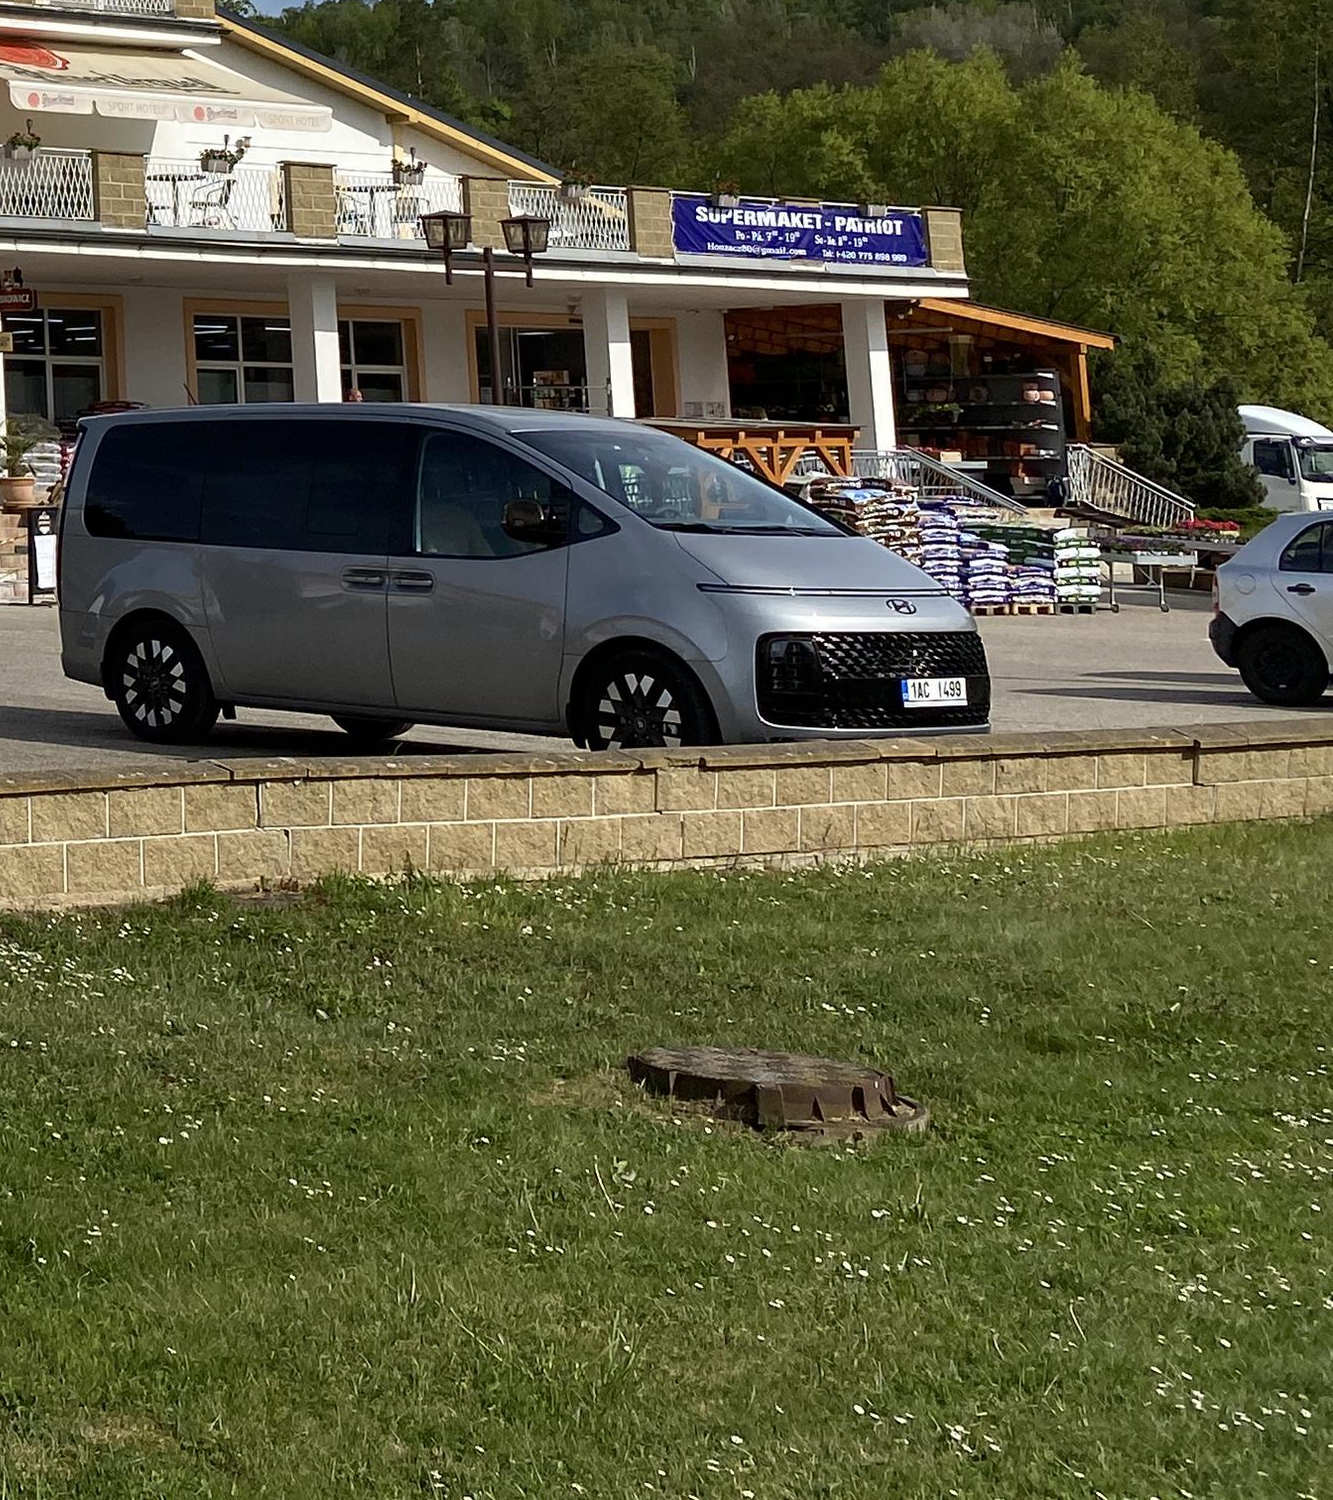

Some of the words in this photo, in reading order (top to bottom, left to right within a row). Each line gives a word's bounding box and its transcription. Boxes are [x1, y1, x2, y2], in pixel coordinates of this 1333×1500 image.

[695, 205, 823, 230] SUPERMAKET
[834, 215, 903, 236] PATRIOT
[911, 681, 930, 699] 1AC
[938, 680, 961, 698] 1499
